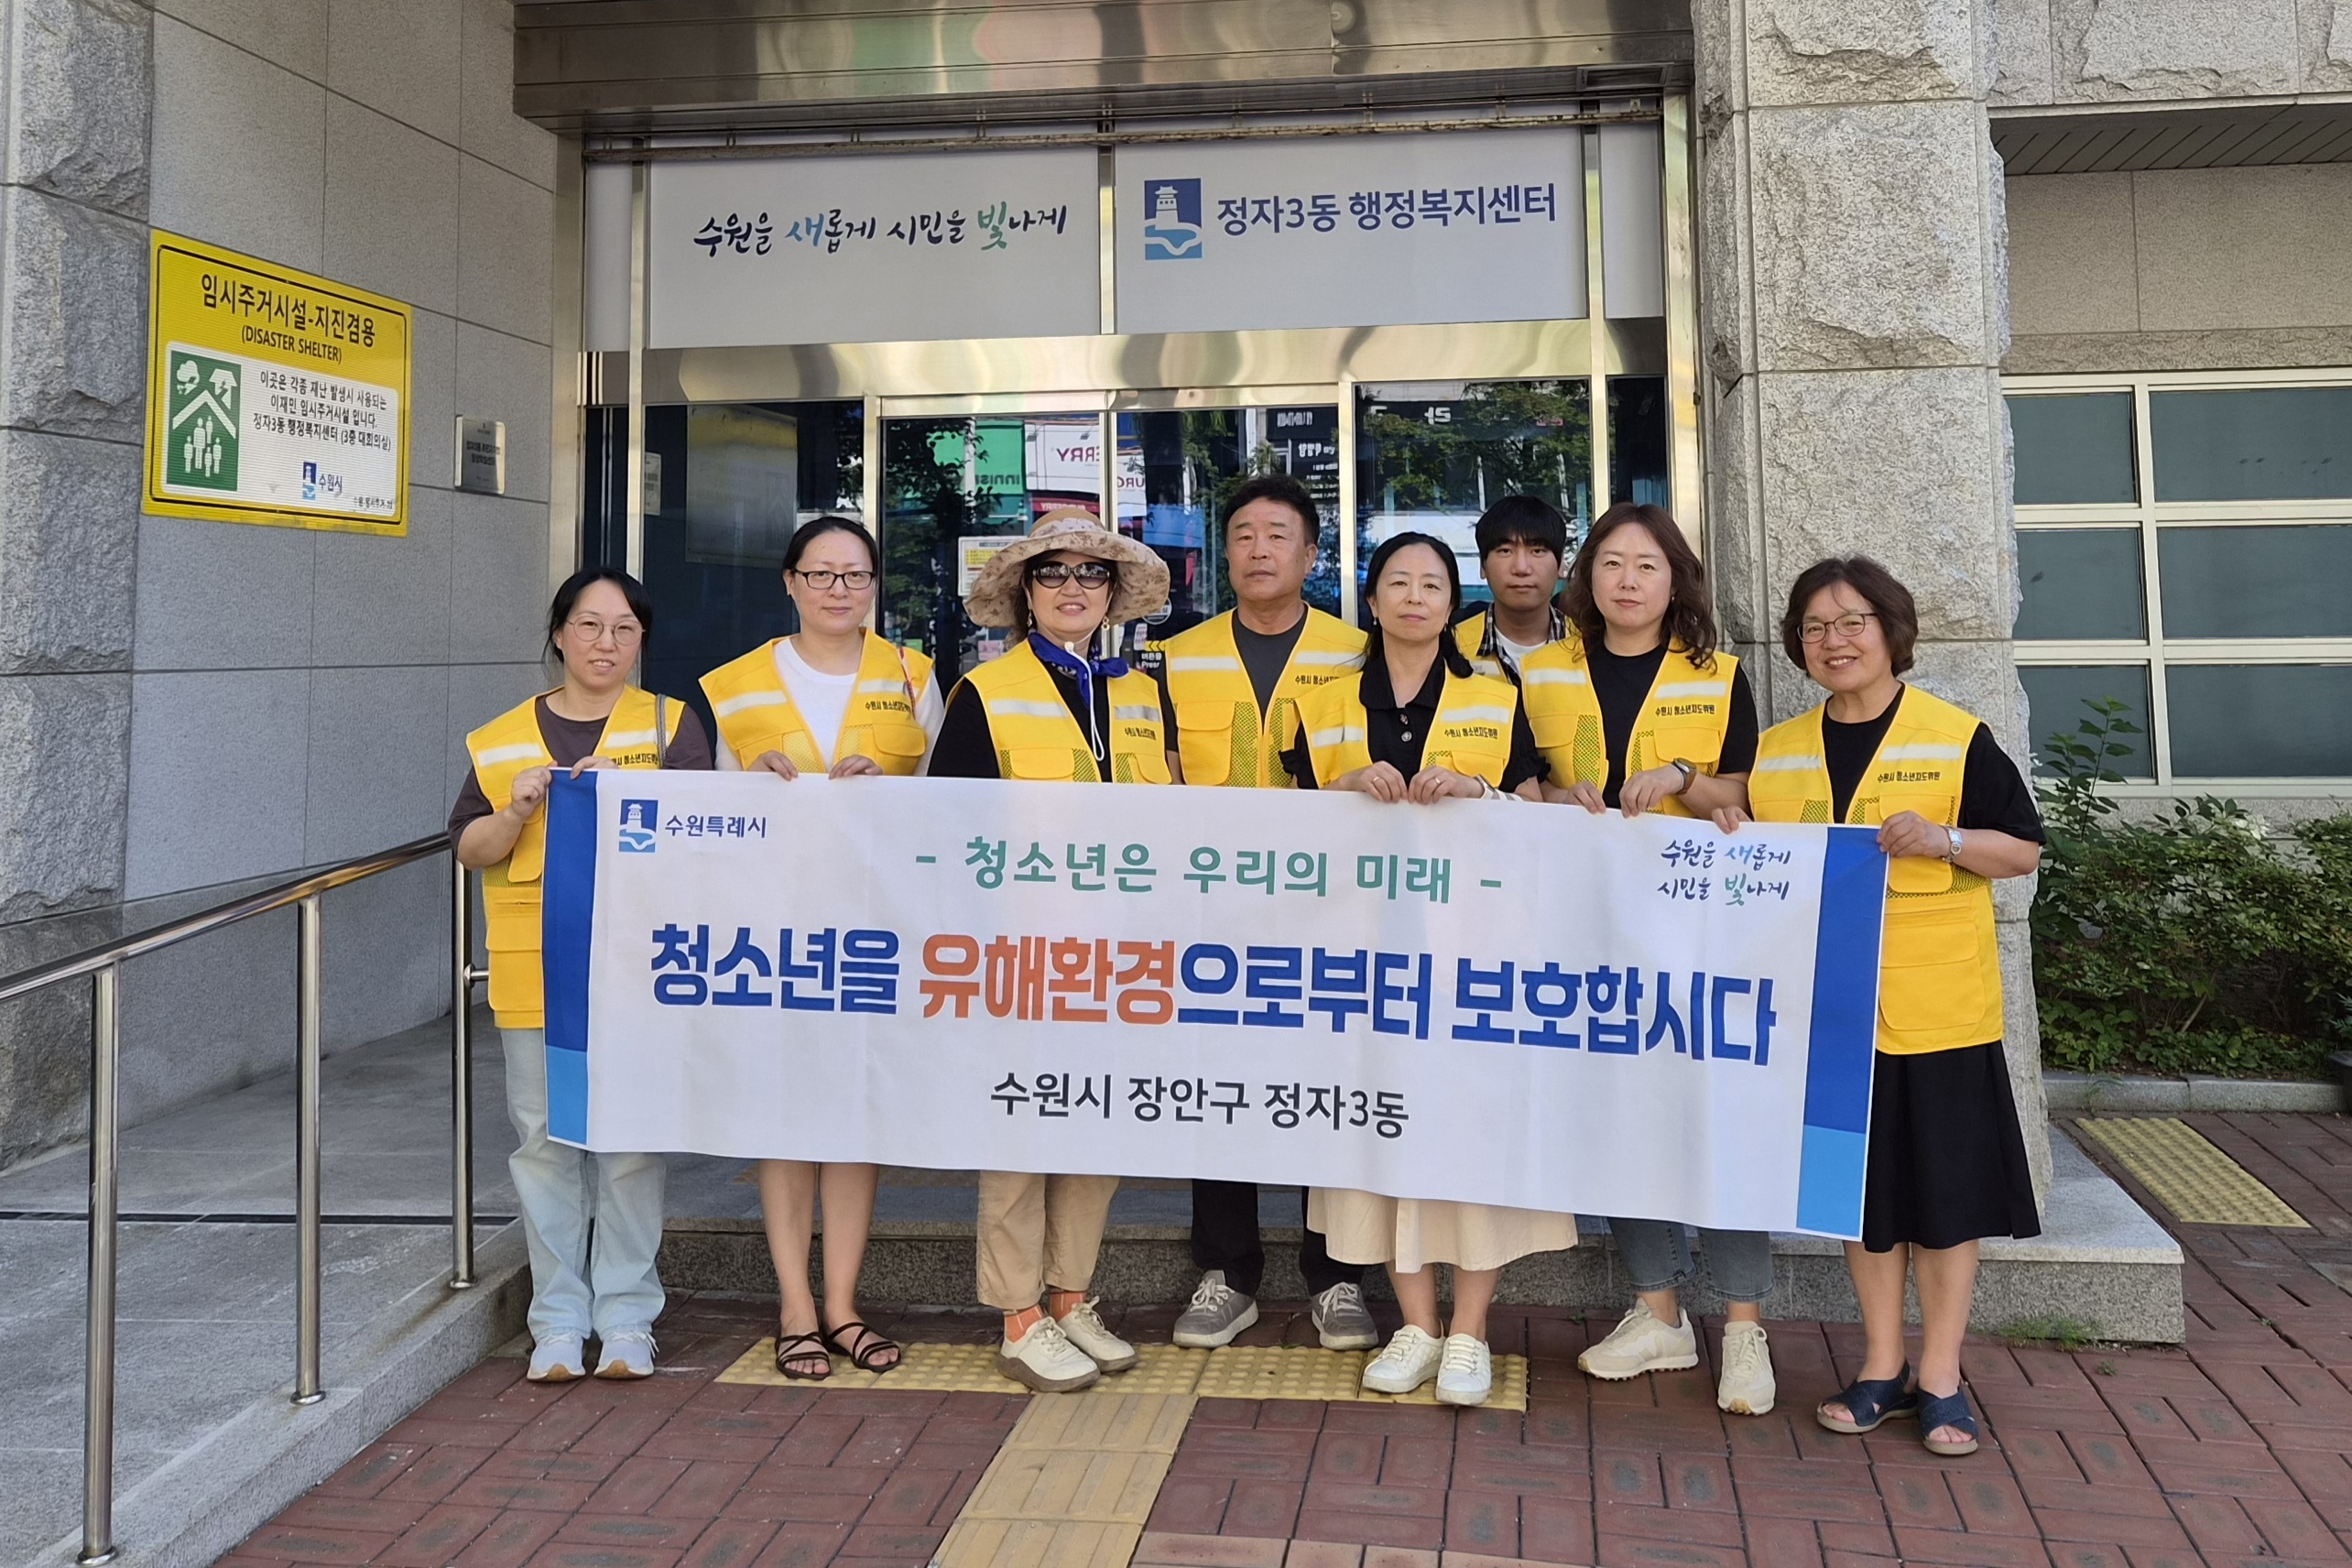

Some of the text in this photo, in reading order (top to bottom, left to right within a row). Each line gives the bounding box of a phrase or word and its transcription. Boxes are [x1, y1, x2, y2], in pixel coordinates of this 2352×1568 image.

[1216, 181, 1556, 236] 정자3동 행정복지센터
[693, 201, 1067, 257] 수원을 새롭게 시민을 빛나게
[201, 273, 376, 348] 임시주거시설-지진겸용
[241, 324, 343, 365] (DISASTER SHELTER)
[260, 370, 287, 391] 이곳은
[310, 381, 327, 399] 재난
[331, 384, 354, 404] 발생시
[357, 391, 387, 410] 사용되는
[270, 394, 377, 429] 이재민 임시주거시설 입니다.
[253, 412, 391, 452] 정자3동 행정복지센터 (3층 대회의실)
[319, 473, 343, 493] 수원시
[1295, 675, 1312, 684] 수원시
[1655, 703, 1715, 716] 수원시 청소년지도위원
[624, 753, 659, 766] 청소년지도위
[1878, 771, 1941, 783] 수원시 청소년지도위원
[664, 814, 768, 839] 수원특례시
[964, 835, 1158, 894] 청소년은
[1182, 845, 1328, 898] 우리의
[1356, 853, 1452, 904] 미래
[1661, 838, 1791, 872] 수원을 새롭게
[1658, 874, 1791, 907] 시민을 빛나게
[651, 924, 1778, 1067] 청소년을 유해환경으로부터 보호합시다
[991, 1072, 1410, 1140] 수원시 장안구 정자3동
